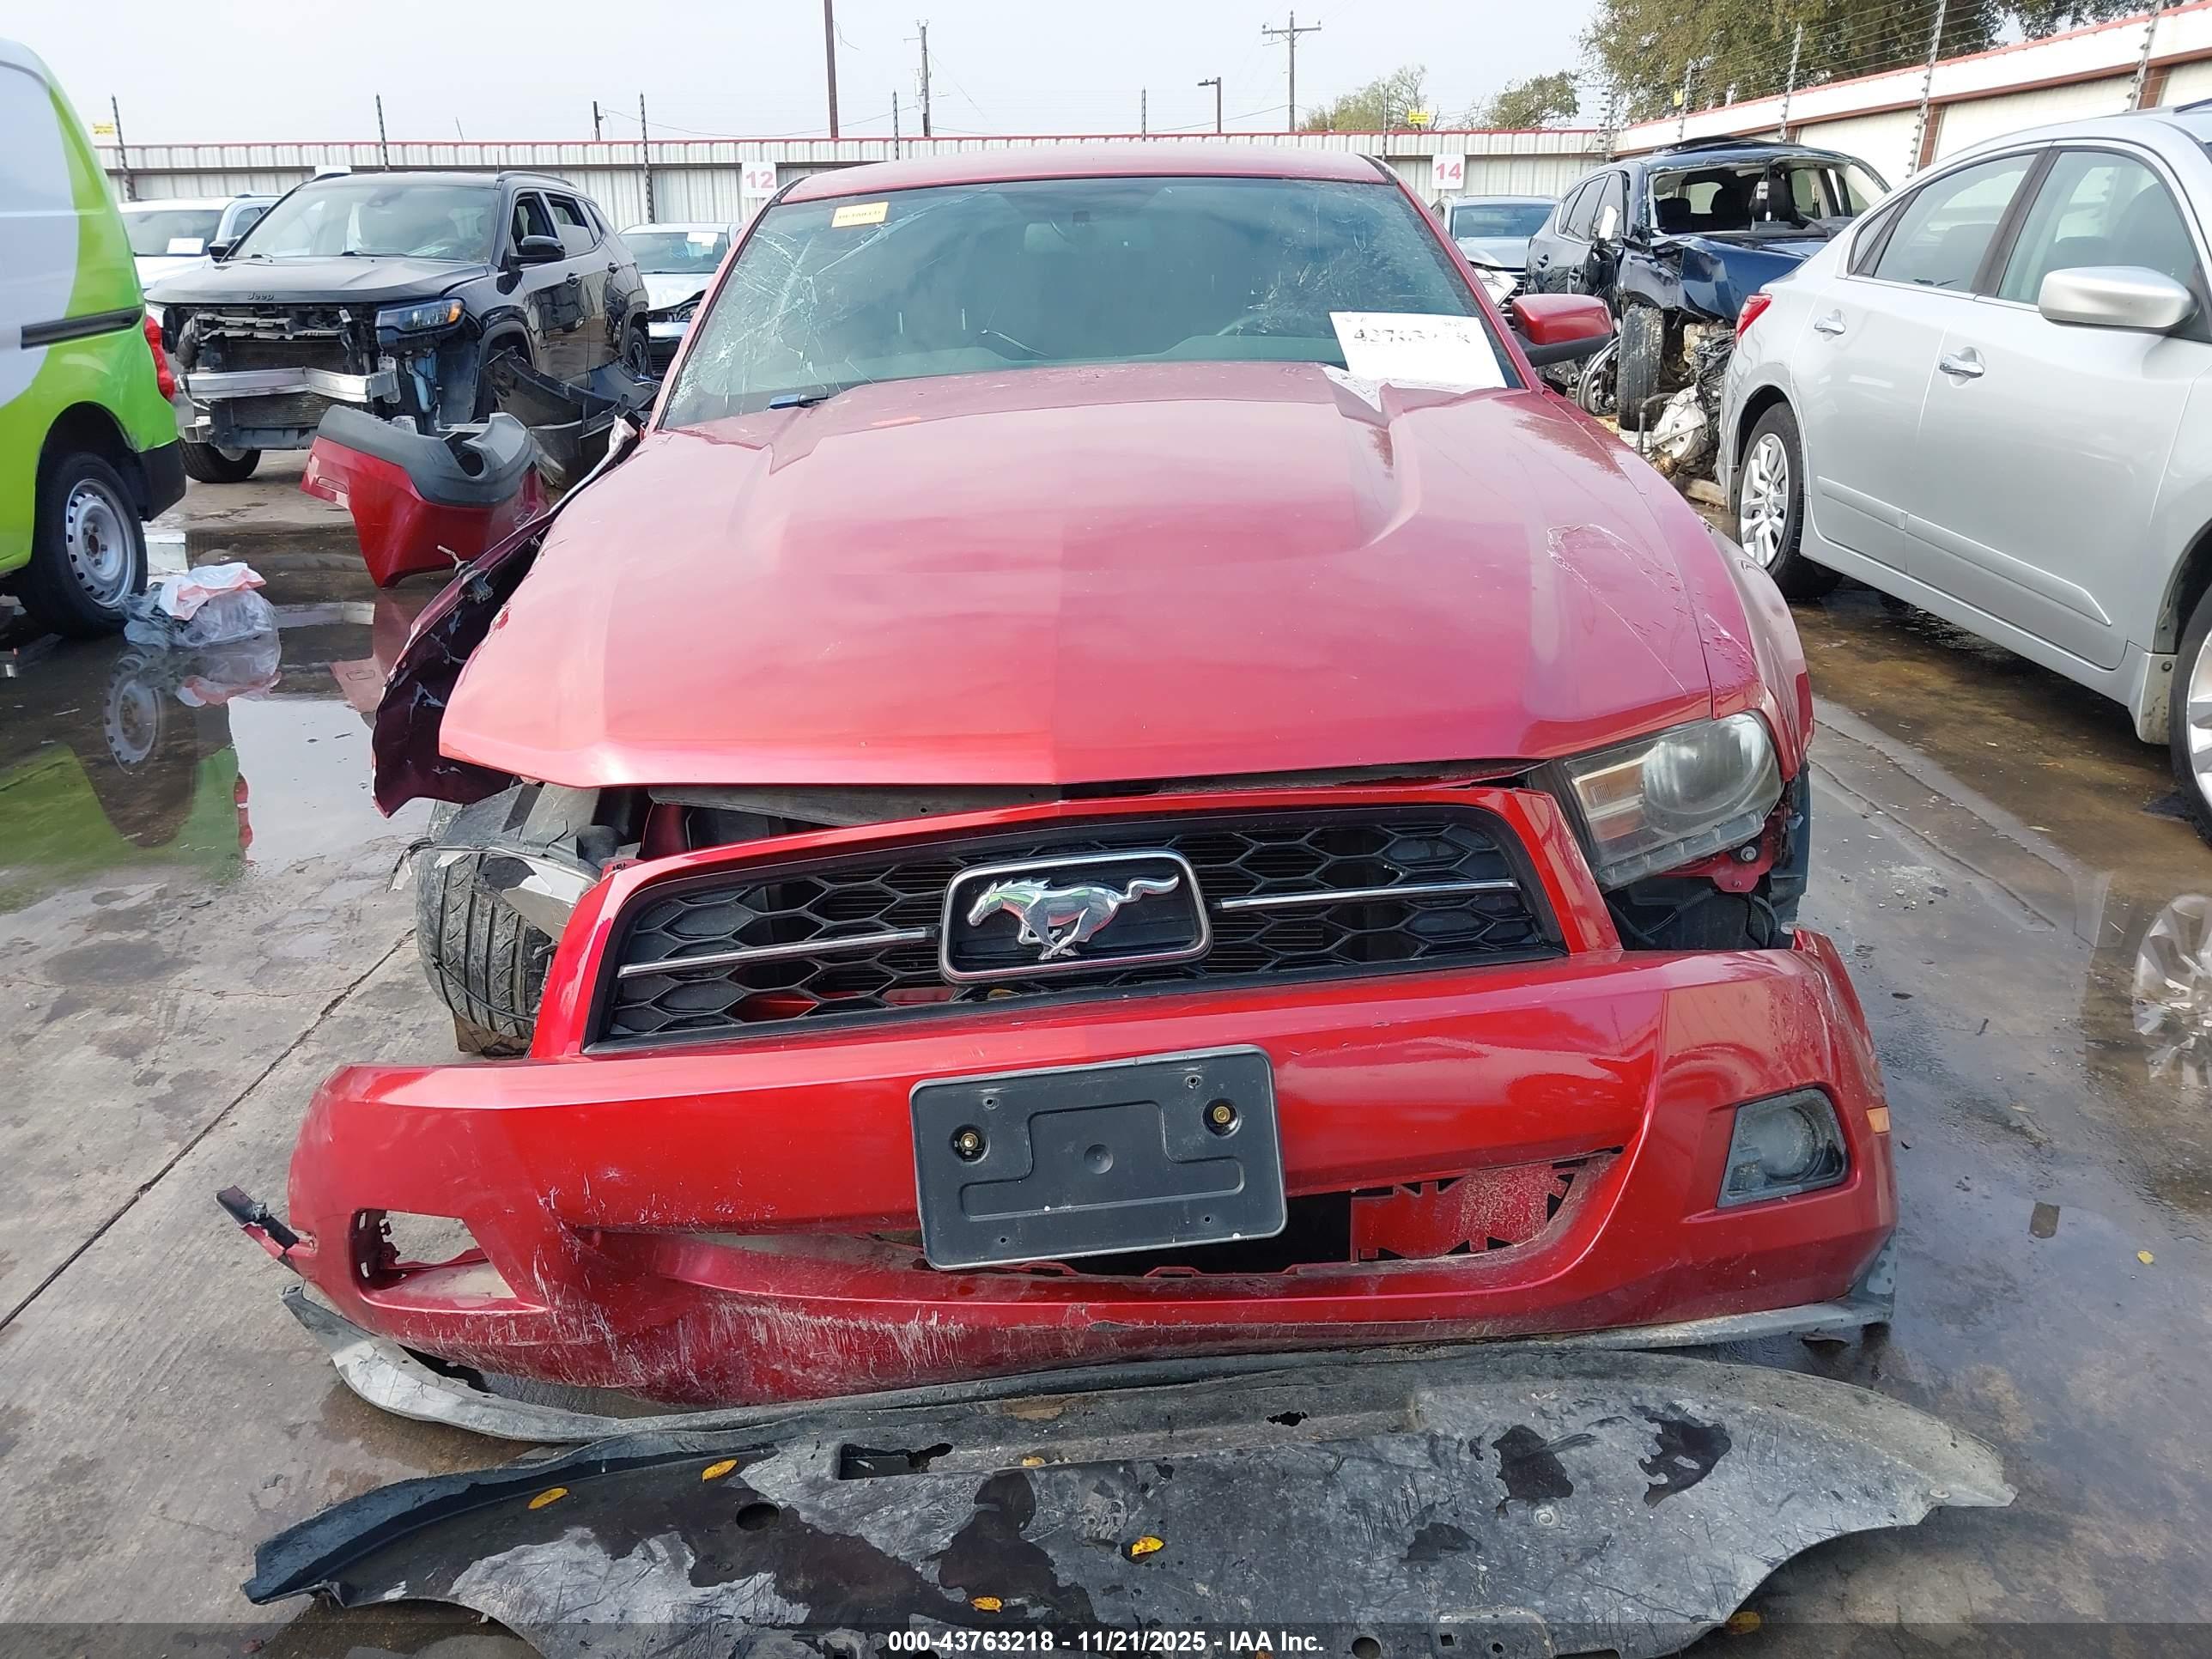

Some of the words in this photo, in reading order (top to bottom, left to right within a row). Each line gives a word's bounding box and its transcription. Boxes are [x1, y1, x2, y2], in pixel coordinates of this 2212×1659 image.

[1436, 163, 1462, 179] 14
[746, 171, 774, 188] 12
[247, 292, 274, 301] Jeep
